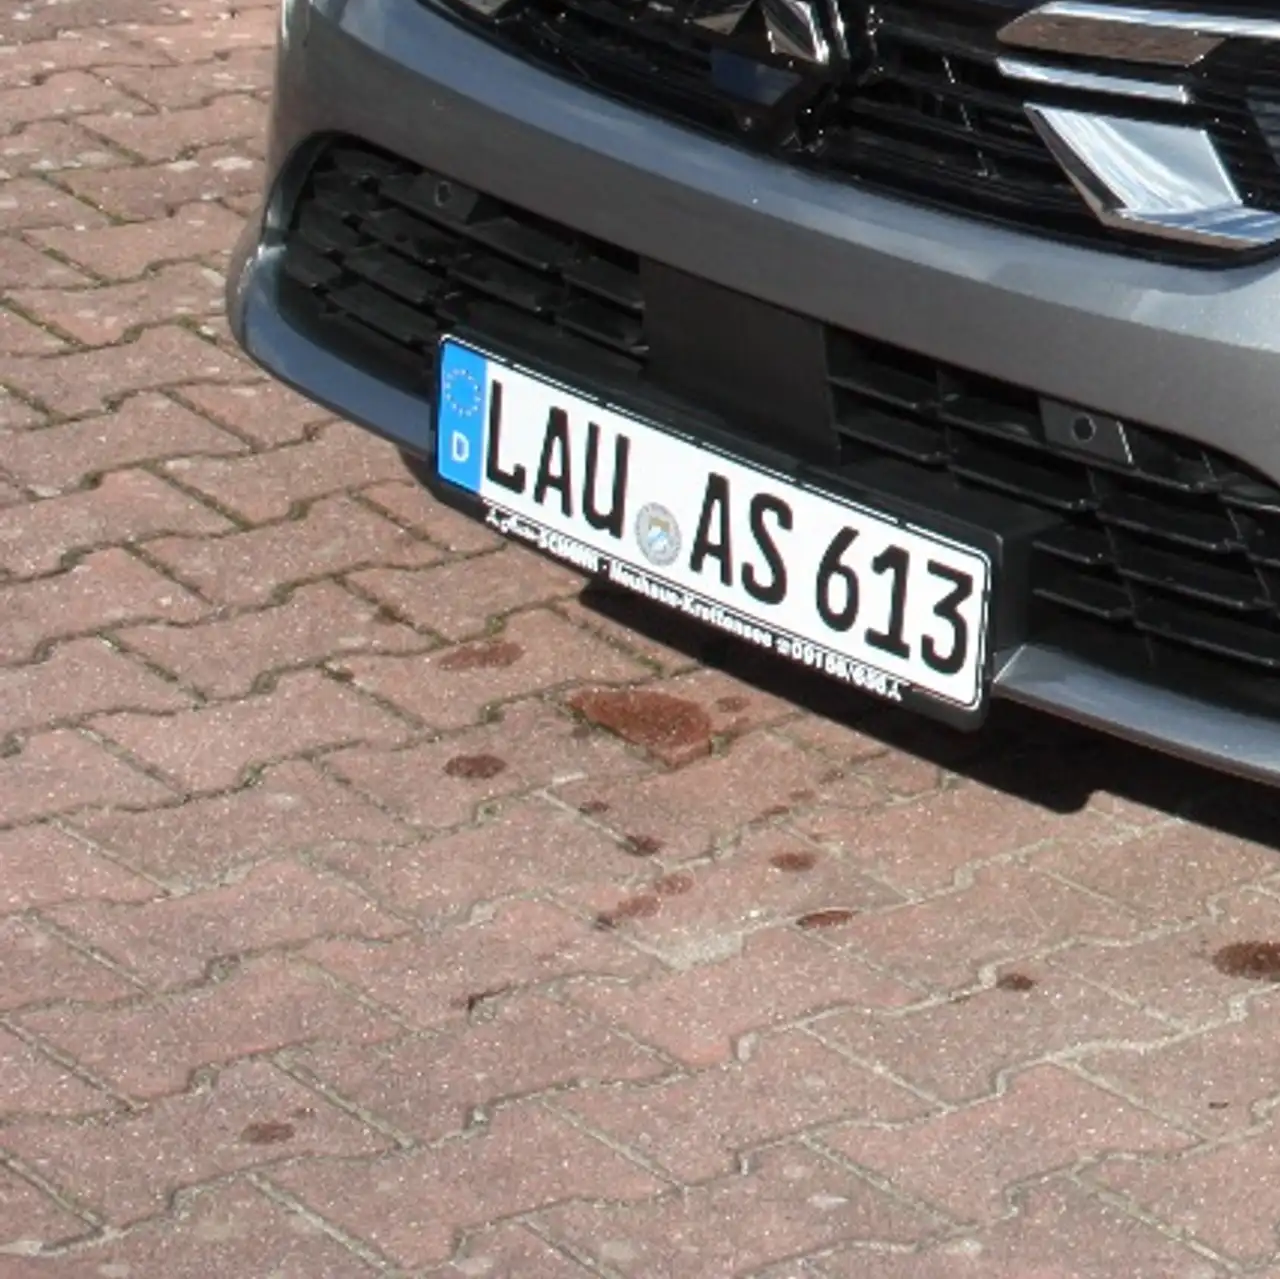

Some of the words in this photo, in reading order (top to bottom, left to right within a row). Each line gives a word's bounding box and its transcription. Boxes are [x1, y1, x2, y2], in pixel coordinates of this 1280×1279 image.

[452, 431, 470, 463] D
[486, 379, 630, 538] LAU
[690, 472, 793, 605] AS
[816, 526, 973, 675] 613
